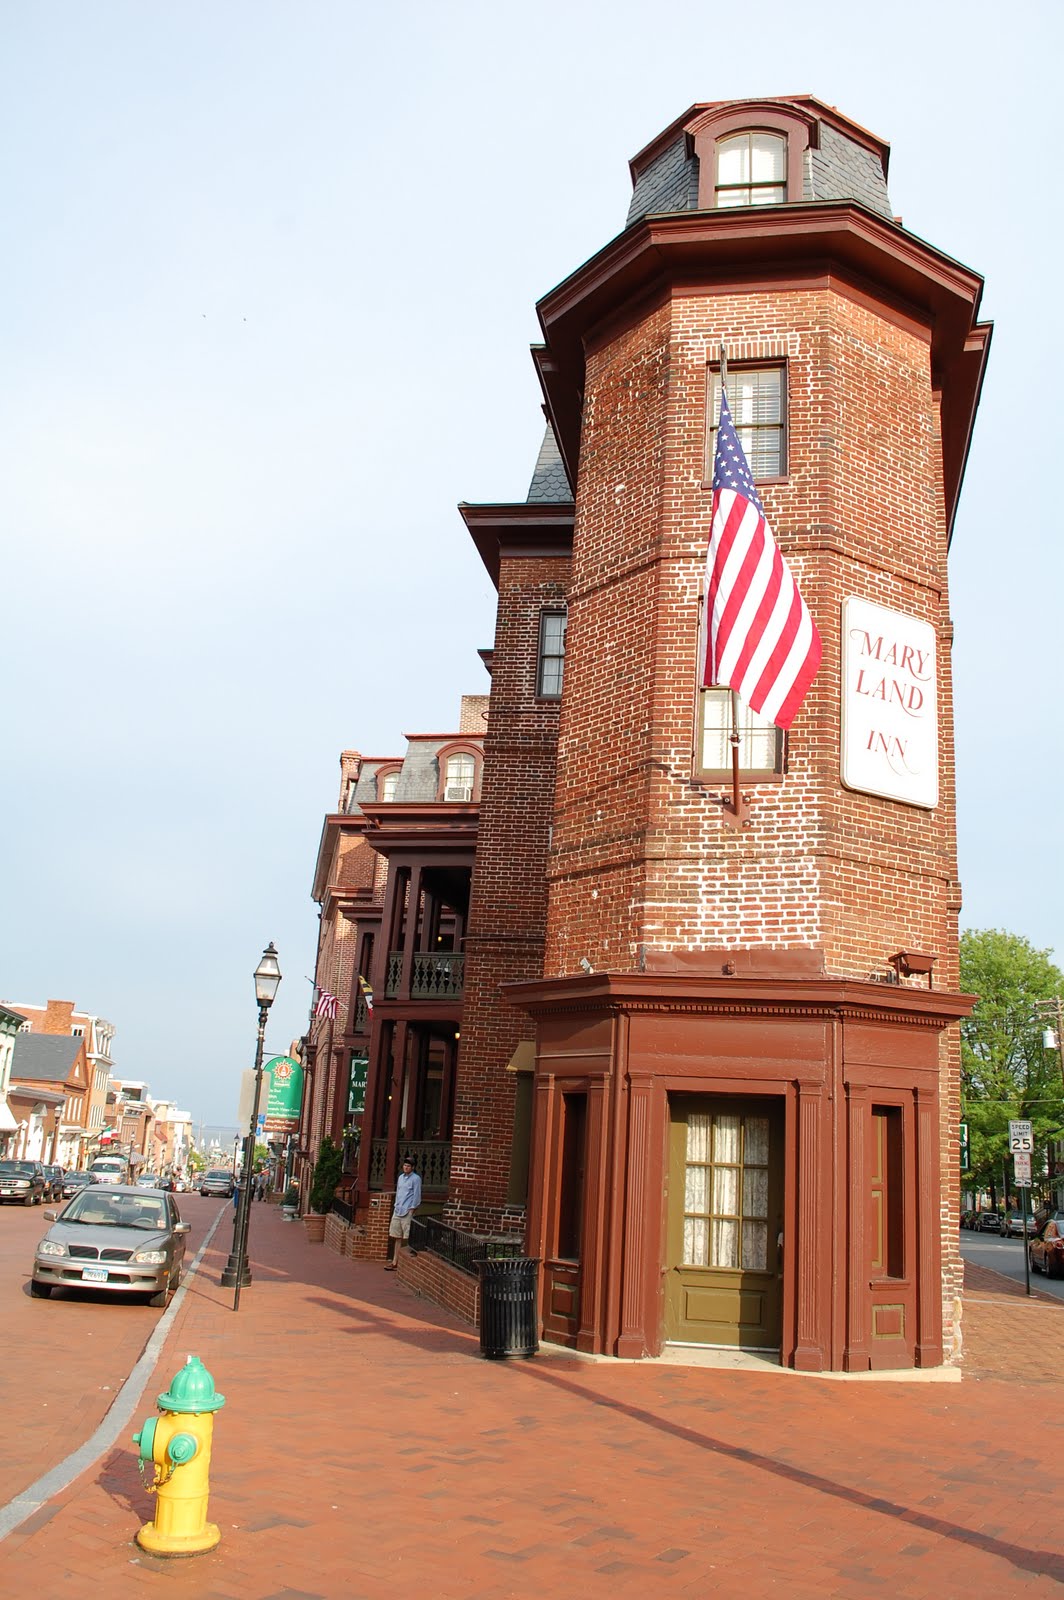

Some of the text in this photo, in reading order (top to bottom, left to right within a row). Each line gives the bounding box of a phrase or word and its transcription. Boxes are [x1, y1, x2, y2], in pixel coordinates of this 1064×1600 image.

[850, 628, 932, 681] MARY
[855, 669, 924, 718] LAND
[866, 730, 920, 776] INN
[1012, 1138, 1030, 1150] 25
